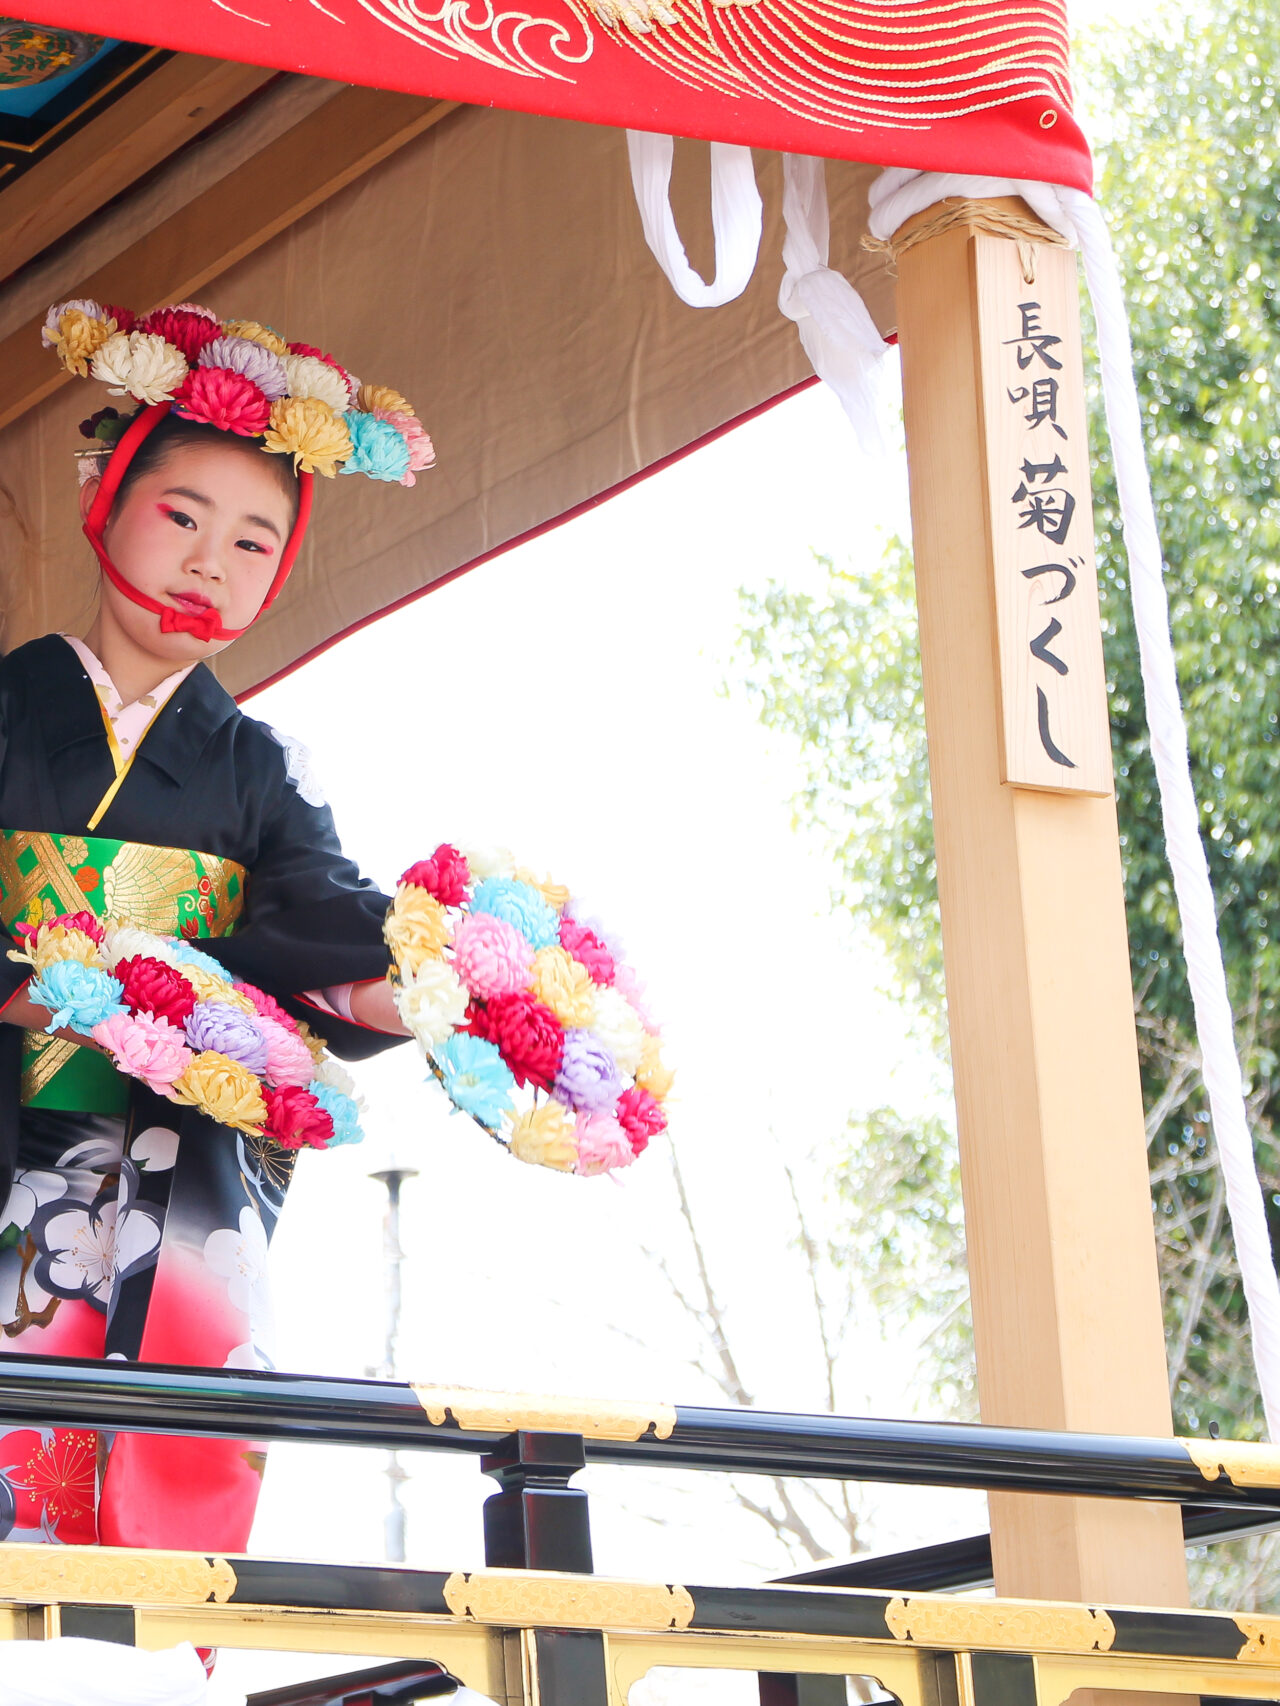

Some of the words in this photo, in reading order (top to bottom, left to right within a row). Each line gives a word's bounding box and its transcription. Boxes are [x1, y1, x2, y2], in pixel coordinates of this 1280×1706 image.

[1001, 301, 1086, 769] 長唄菊づくし
